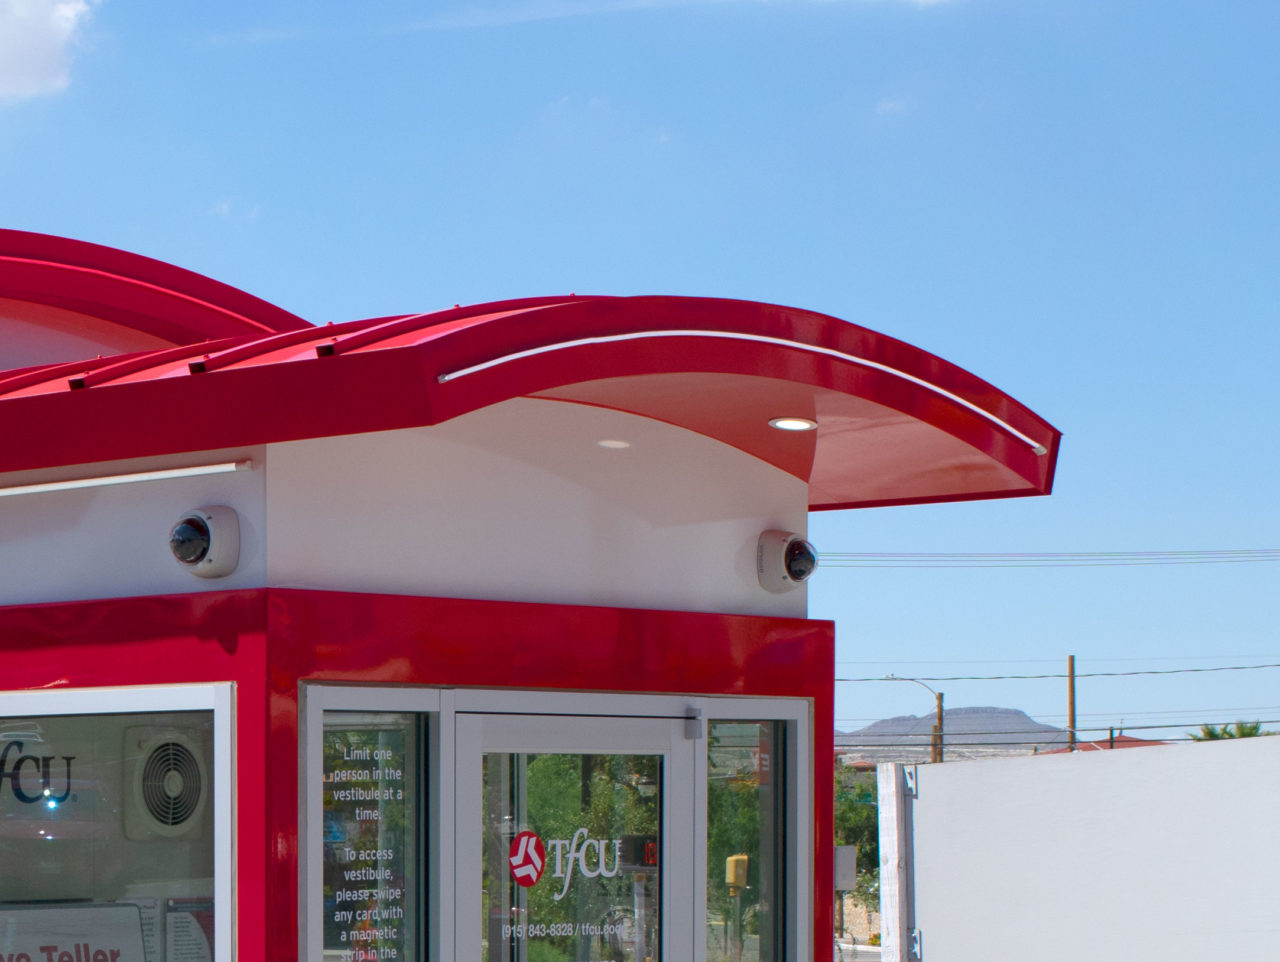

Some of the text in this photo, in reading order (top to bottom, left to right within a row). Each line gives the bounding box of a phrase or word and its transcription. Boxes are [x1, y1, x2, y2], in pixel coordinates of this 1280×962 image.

[343, 747, 392, 760] Limit one
[334, 767, 402, 783] person in the
[333, 787, 403, 801] vestibule at a
[344, 847, 393, 861] To access
[344, 867, 393, 881] vestibule,
[336, 886, 402, 904] please swipe
[334, 906, 404, 924] any card with
[340, 926, 398, 942] a magnetic
[501, 924, 526, 939] (915)
[528, 924, 574, 937] 843-8328
[341, 946, 397, 962] strip in the
